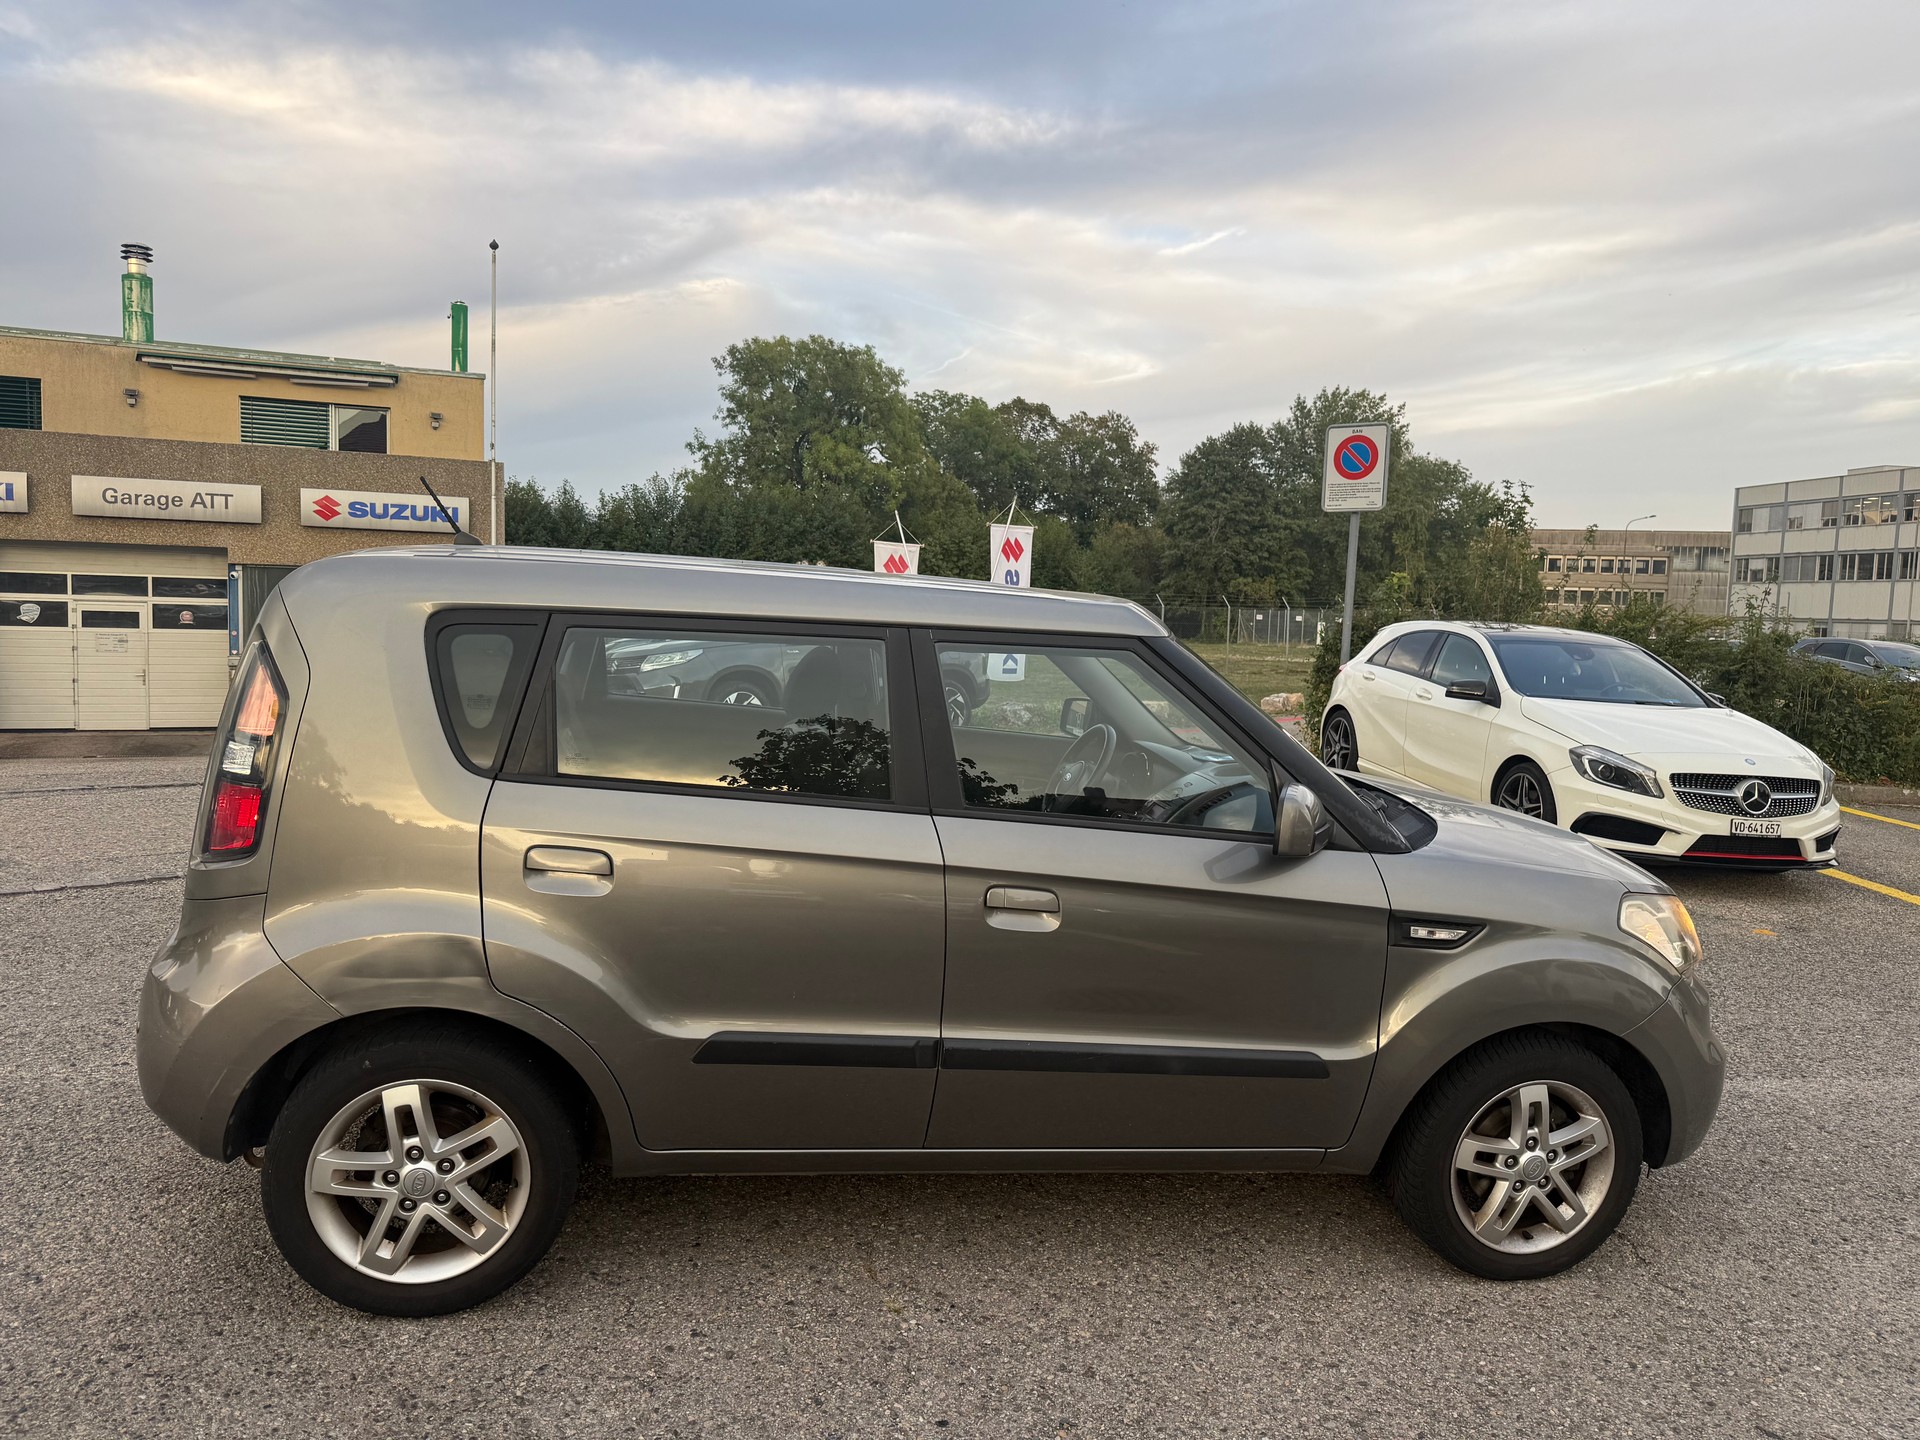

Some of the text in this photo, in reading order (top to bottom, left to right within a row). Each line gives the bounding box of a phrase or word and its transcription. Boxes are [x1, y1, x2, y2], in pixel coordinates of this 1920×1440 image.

[102, 487, 234, 511] Garage ATT
[347, 501, 459, 523] SUZUKI
